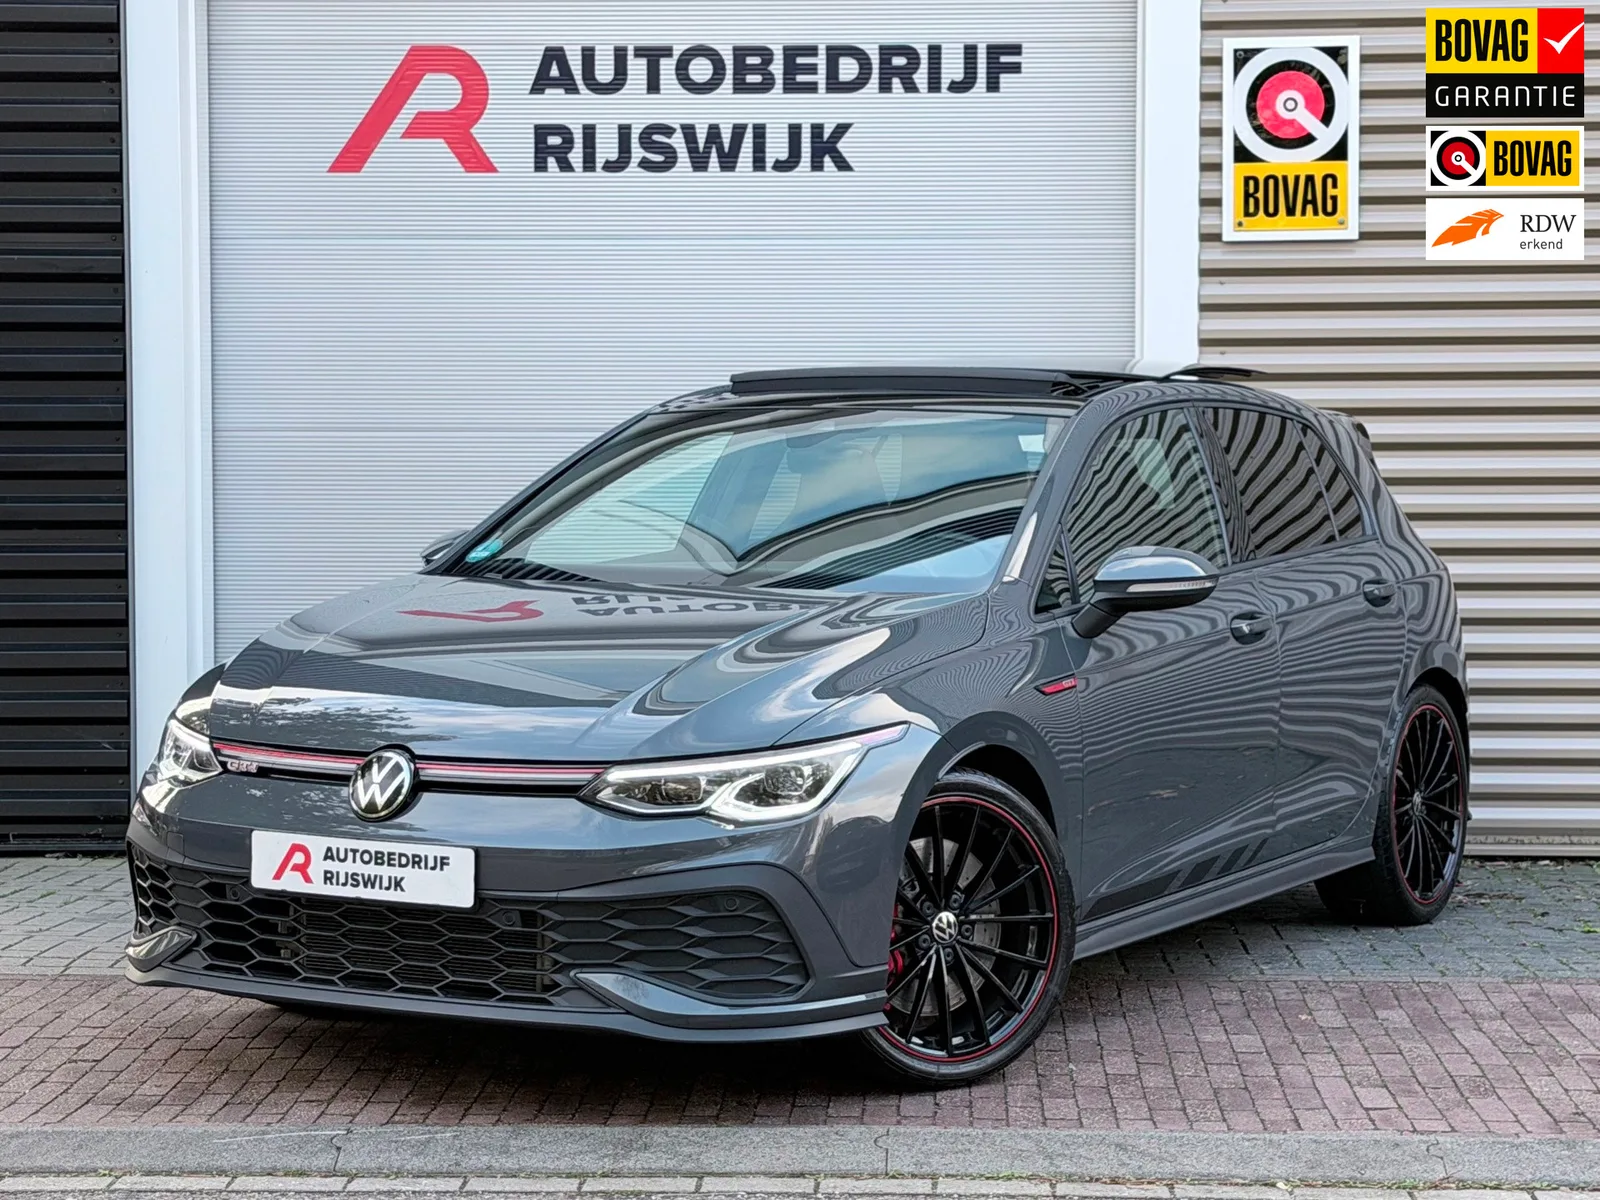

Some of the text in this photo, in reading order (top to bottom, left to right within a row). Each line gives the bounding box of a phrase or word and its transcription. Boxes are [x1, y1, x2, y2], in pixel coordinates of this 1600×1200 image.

[529, 43, 1023, 95] AUTOBEDRIJF
[533, 123, 854, 172] RIJSWIJK
[1243, 173, 1338, 218] BOVAG
[227, 760, 259, 773] GTI
[322, 846, 450, 871] AUTOBEDRIJF
[322, 870, 406, 892] RIJSWIJK
